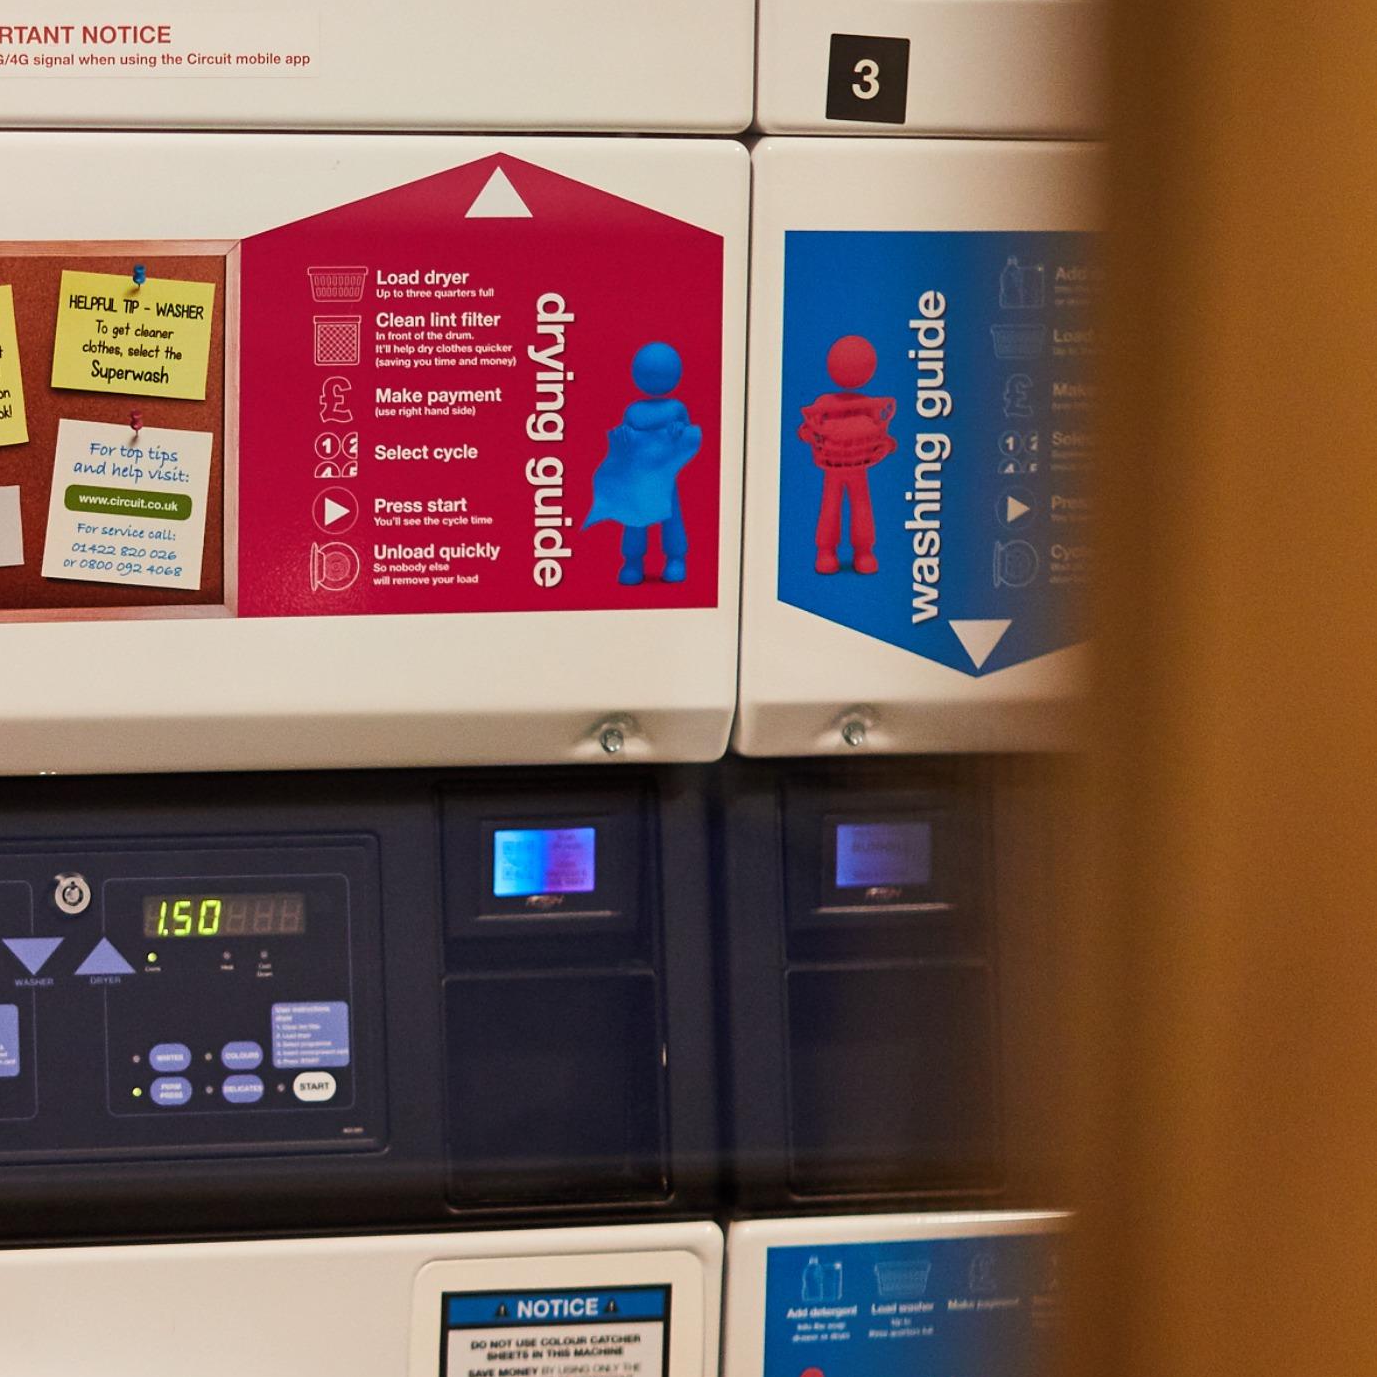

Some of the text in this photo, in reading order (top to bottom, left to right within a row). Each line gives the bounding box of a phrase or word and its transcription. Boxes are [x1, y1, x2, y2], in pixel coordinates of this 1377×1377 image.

[82, 25, 171, 44] NOTICE
[33, 53, 74, 68] signal
[78, 53, 115, 65] when
[120, 53, 156, 67] using
[161, 53, 182, 65] the
[186, 52, 231, 65] Circuit
[236, 52, 281, 64] mobile
[285, 55, 310, 67] app
[852, 58, 880, 100] 3
[376, 269, 469, 287] Load dryer
[69, 294, 117, 313] HELPFUL
[122, 298, 139, 314] TIP
[155, 302, 204, 320] WASHER
[95, 319, 174, 339] To get cleaner
[376, 311, 501, 328] Clean lint filter
[82, 340, 182, 360] clothes, select the
[90, 360, 168, 384] Superwash
[375, 387, 501, 404] Make payment
[374, 405, 476, 418] (use right hand side)
[525, 292, 574, 588] drying guide
[89, 442, 178, 465] For top tips
[374, 443, 478, 461] Select cycle
[904, 290, 953, 624] washing guide
[73, 461, 189, 483] and help visit:
[78, 494, 178, 511] www.circuit.co.uk
[374, 497, 467, 513] Press start
[77, 522, 175, 541] For service call:
[71, 542, 177, 560] 01422 820 026
[373, 543, 500, 562] Unload quickly
[63, 558, 182, 577] or 0800 092 4068
[158, 899, 223, 936] 1.50
[299, 1081, 330, 1092] START
[517, 1297, 598, 1318] NOTICE
